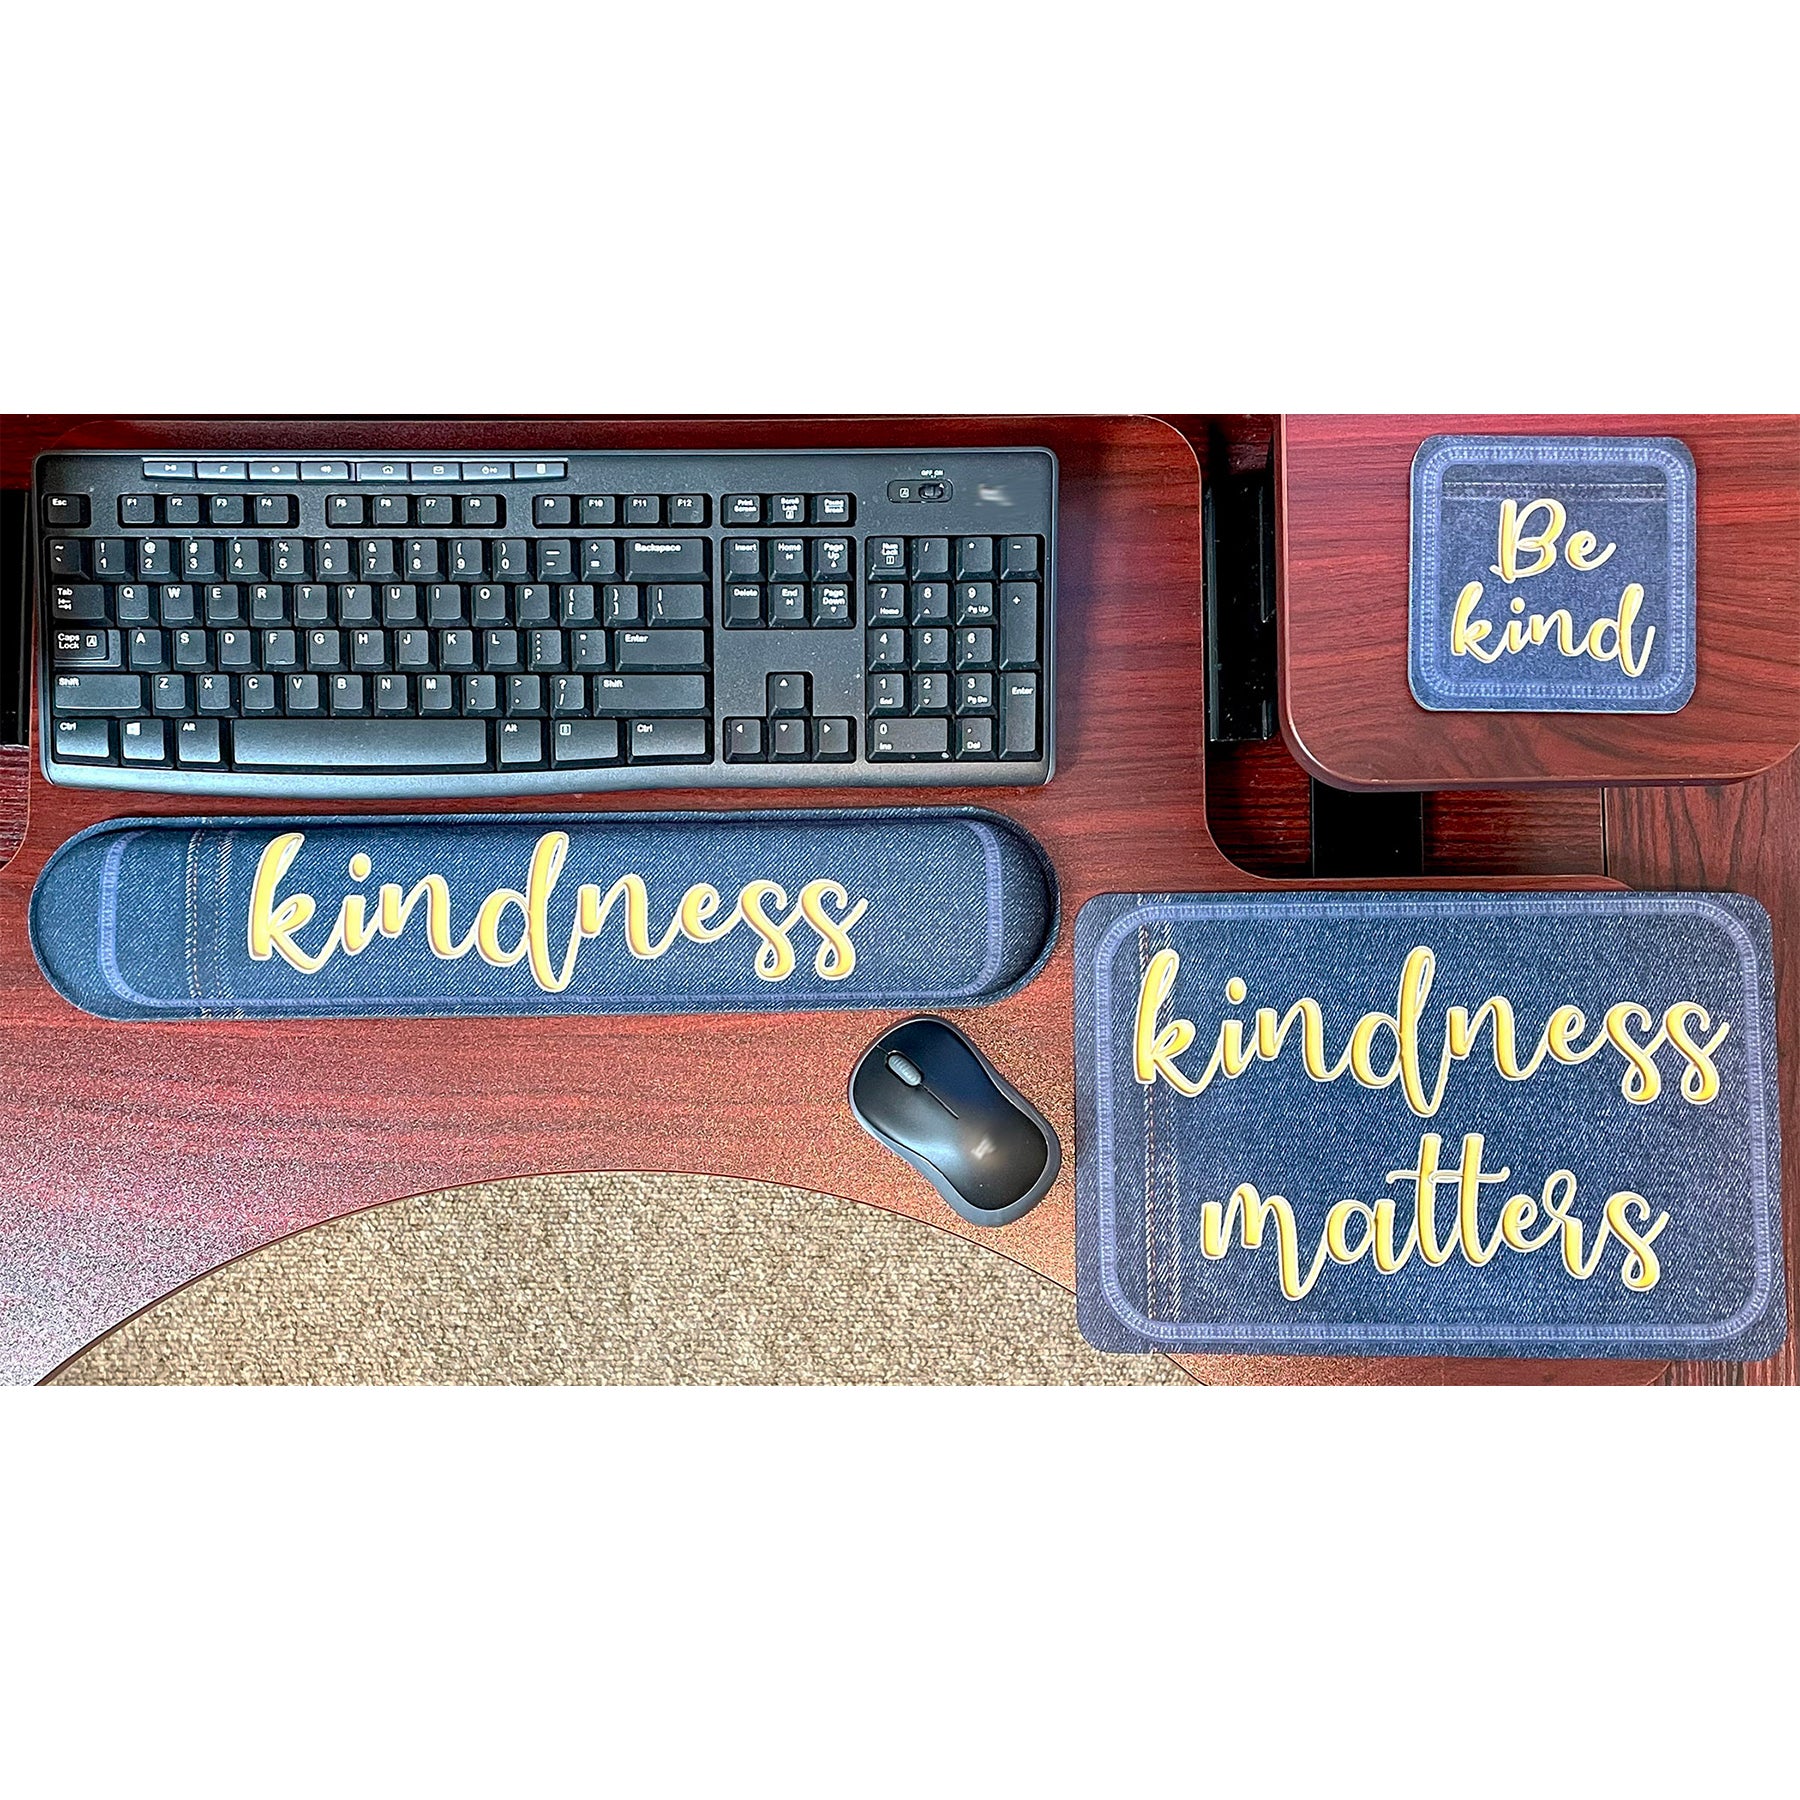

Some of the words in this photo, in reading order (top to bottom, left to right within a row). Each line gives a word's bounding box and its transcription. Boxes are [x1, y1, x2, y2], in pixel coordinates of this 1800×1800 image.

[1490, 498, 1616, 582] Be
[458, 543, 461, 554] (
[502, 543, 506, 555] )
[635, 543, 681, 553] Backspace
[778, 543, 801, 551] Home
[824, 543, 843, 552] Page
[828, 552, 839, 560] Up
[101, 558, 106, 568] 1
[145, 559, 152, 568] 2
[190, 558, 197, 568] 3
[235, 559, 243, 568] 4
[279, 558, 287, 568] 5
[324, 559, 332, 569] 6
[369, 559, 376, 568] 7
[413, 559, 421, 569] 8
[458, 559, 465, 569] 9
[502, 559, 509, 569] 0
[124, 588, 133, 600] Q
[168, 588, 180, 598] W
[213, 588, 221, 598] E
[258, 588, 266, 598] R
[303, 588, 311, 598] T
[347, 589, 355, 598] Y
[392, 589, 400, 599] U
[480, 589, 490, 599] O
[525, 589, 532, 599] P
[824, 589, 843, 598] Page
[881, 588, 887, 598] 7
[924, 588, 931, 598] 8
[968, 588, 975, 598] 9
[823, 597, 845, 605] Down
[1450, 581, 1655, 678] kind
[58, 634, 80, 642] Caps
[136, 633, 145, 643] A
[181, 633, 189, 643] S
[225, 633, 234, 643] D
[270, 633, 277, 644] F
[314, 634, 324, 644] G
[359, 634, 368, 644] H
[404, 634, 410, 644] J
[448, 634, 456, 644] K
[492, 634, 499, 644] L
[625, 634, 648, 642] Enter
[880, 634, 887, 644] 4
[924, 633, 931, 644] 5
[968, 633, 975, 643] 6
[59, 678, 79, 686] Shift
[160, 678, 168, 688] Z
[204, 678, 212, 688] X
[249, 678, 258, 689] C
[293, 679, 302, 689] V
[338, 678, 346, 689] B
[382, 679, 390, 689] N
[426, 679, 436, 689] M
[560, 680, 566, 689] ?
[880, 679, 885, 688] 1
[924, 678, 931, 689] 2
[968, 678, 975, 688] 3
[1012, 687, 1033, 695] Enter
[637, 724, 652, 732] Ctrl
[880, 724, 887, 734] 0
[967, 741, 980, 749] Del
[248, 832, 869, 993] kindness
[1133, 944, 1730, 1118] kindness
[1200, 1133, 1670, 1302] matters
